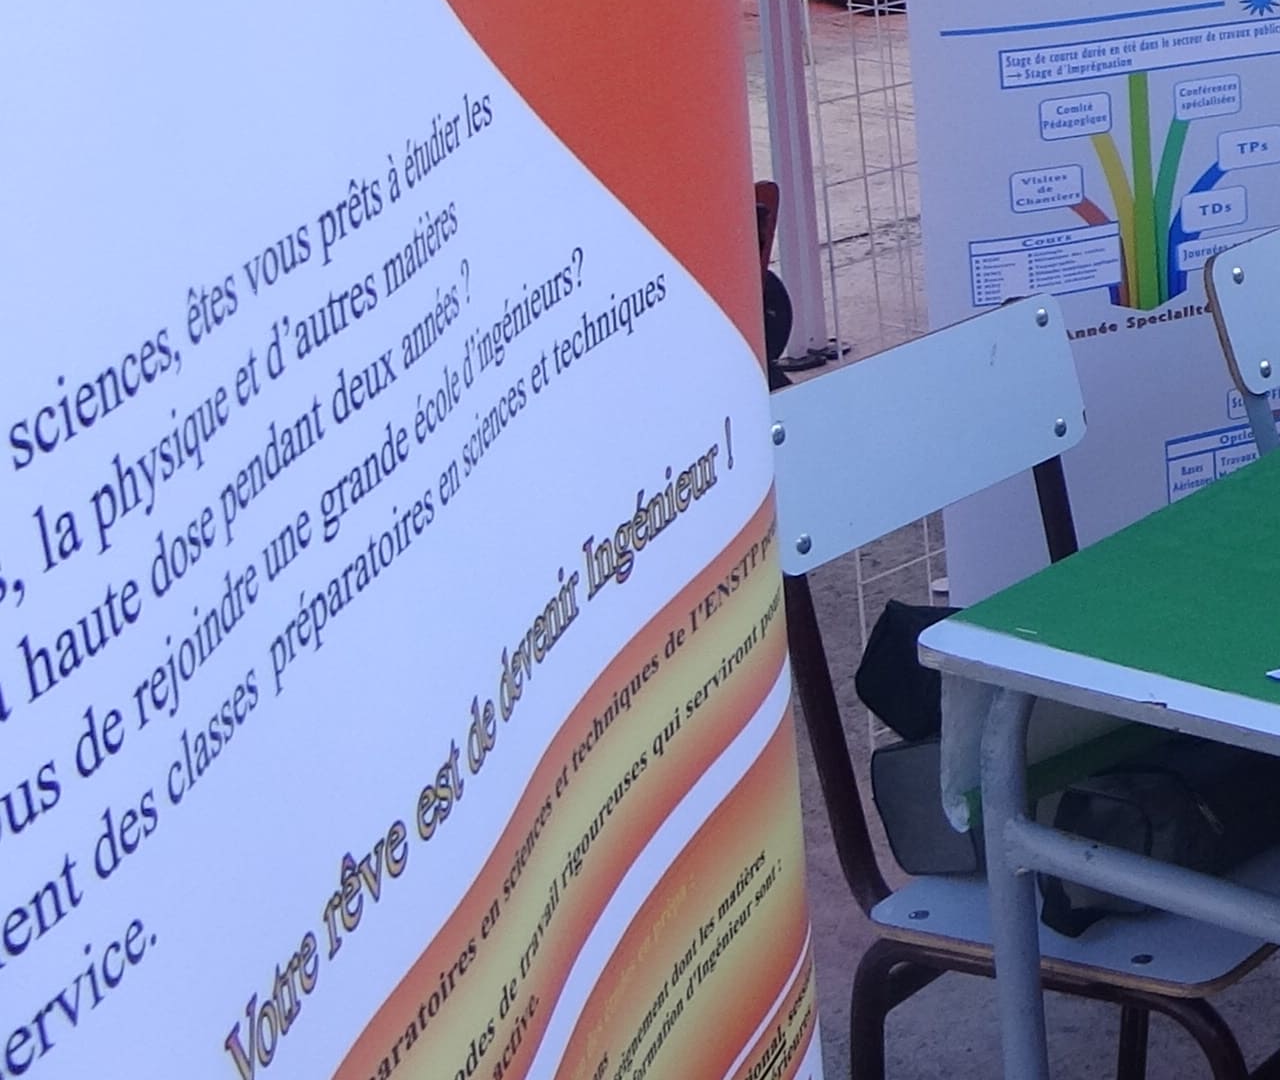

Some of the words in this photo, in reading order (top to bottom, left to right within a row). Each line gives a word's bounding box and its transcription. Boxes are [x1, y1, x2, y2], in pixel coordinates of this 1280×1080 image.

[9, 327, 182, 471] sciences,
[186, 274, 238, 345] êtes
[243, 223, 311, 296] vous
[318, 178, 383, 266] prêts
[387, 153, 401, 203] à
[405, 112, 460, 189] étudier
[465, 93, 493, 139] les
[1199, 201, 1232, 217] TDs
[1237, 141, 1269, 157] TPs
[17, 578, 142, 703] haute
[151, 506, 216, 598] dose
[219, 394, 326, 547] pendant
[332, 348, 398, 425] deux
[402, 283, 460, 370] années
[33, 504, 83, 573] la
[89, 385, 229, 556] physique
[235, 347, 261, 407] et
[382, 201, 458, 297] matières
[75, 705, 125, 778] de
[133, 563, 259, 730] rejoindre
[262, 509, 312, 583] une
[320, 421, 410, 544] grande
[415, 364, 460, 446] école
[224, 931, 319, 1080] Votre
[323, 820, 408, 960] rêve
[416, 738, 464, 841] est
[467, 695, 497, 775] de
[499, 567, 579, 723] devenir
[582, 443, 719, 602] Ingénieur
